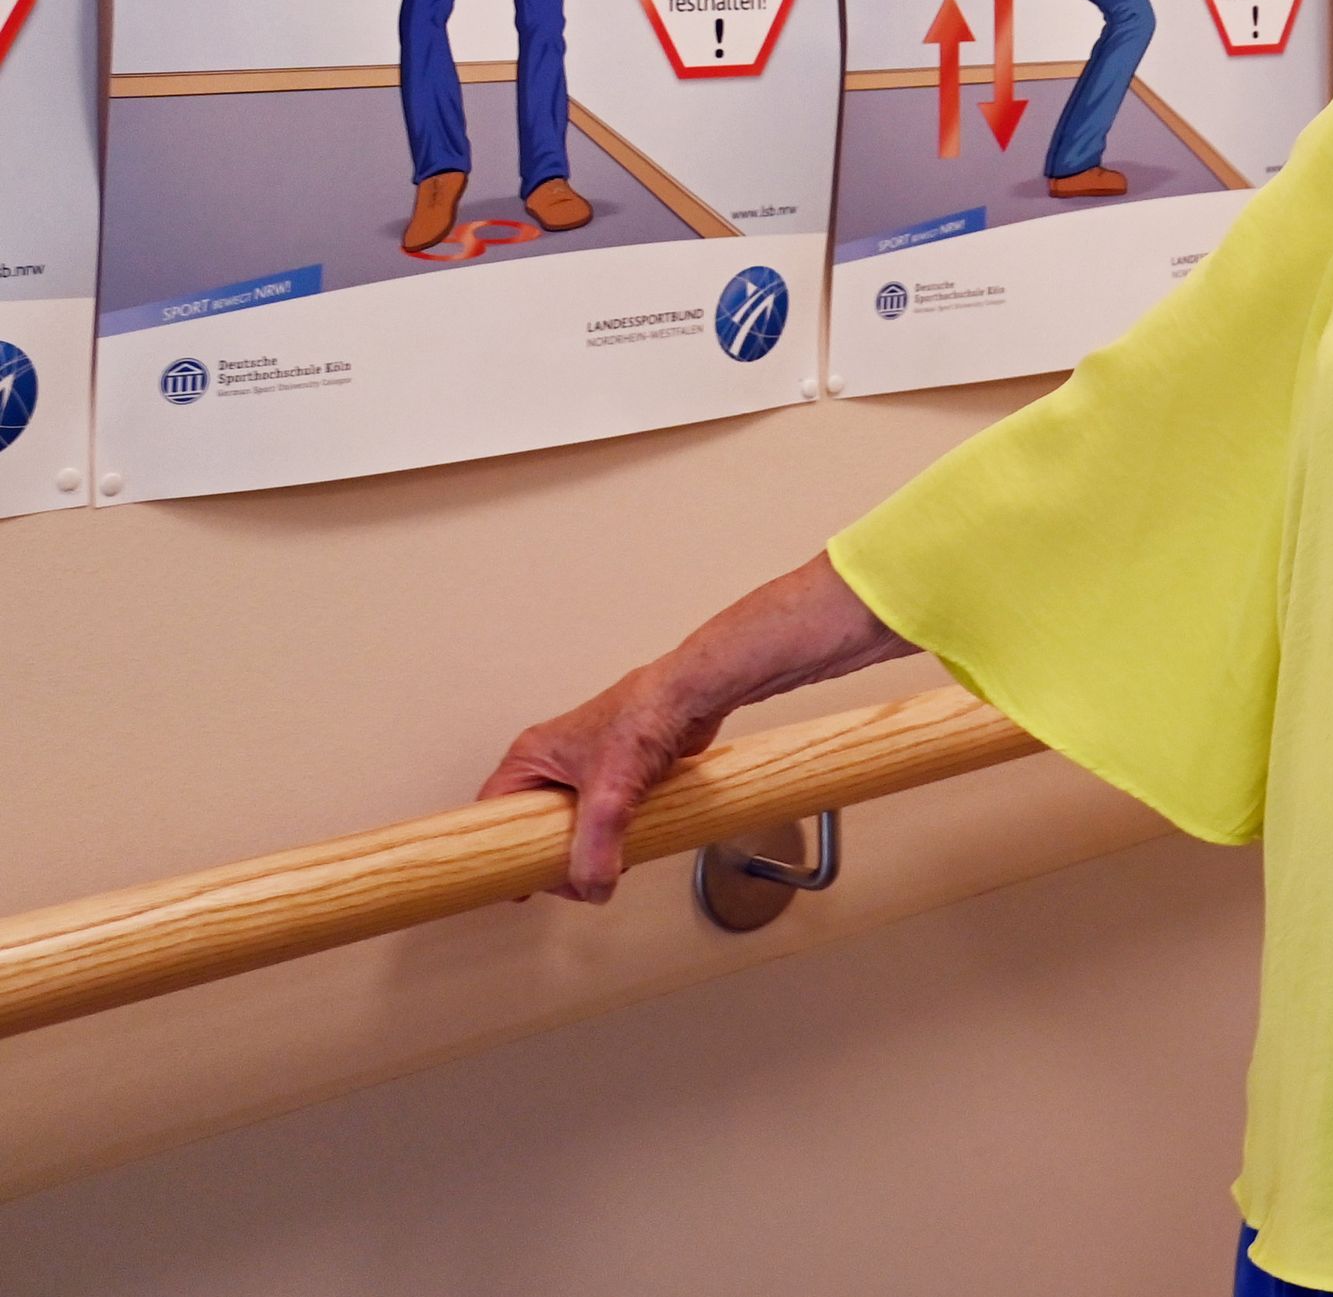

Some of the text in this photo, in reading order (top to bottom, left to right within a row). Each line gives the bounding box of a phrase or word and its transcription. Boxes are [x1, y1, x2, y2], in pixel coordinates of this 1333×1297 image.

[162, 299, 210, 321] SPORT
[587, 309, 704, 332] LANDESSPORTBUND
[218, 356, 277, 370] Deutsche
